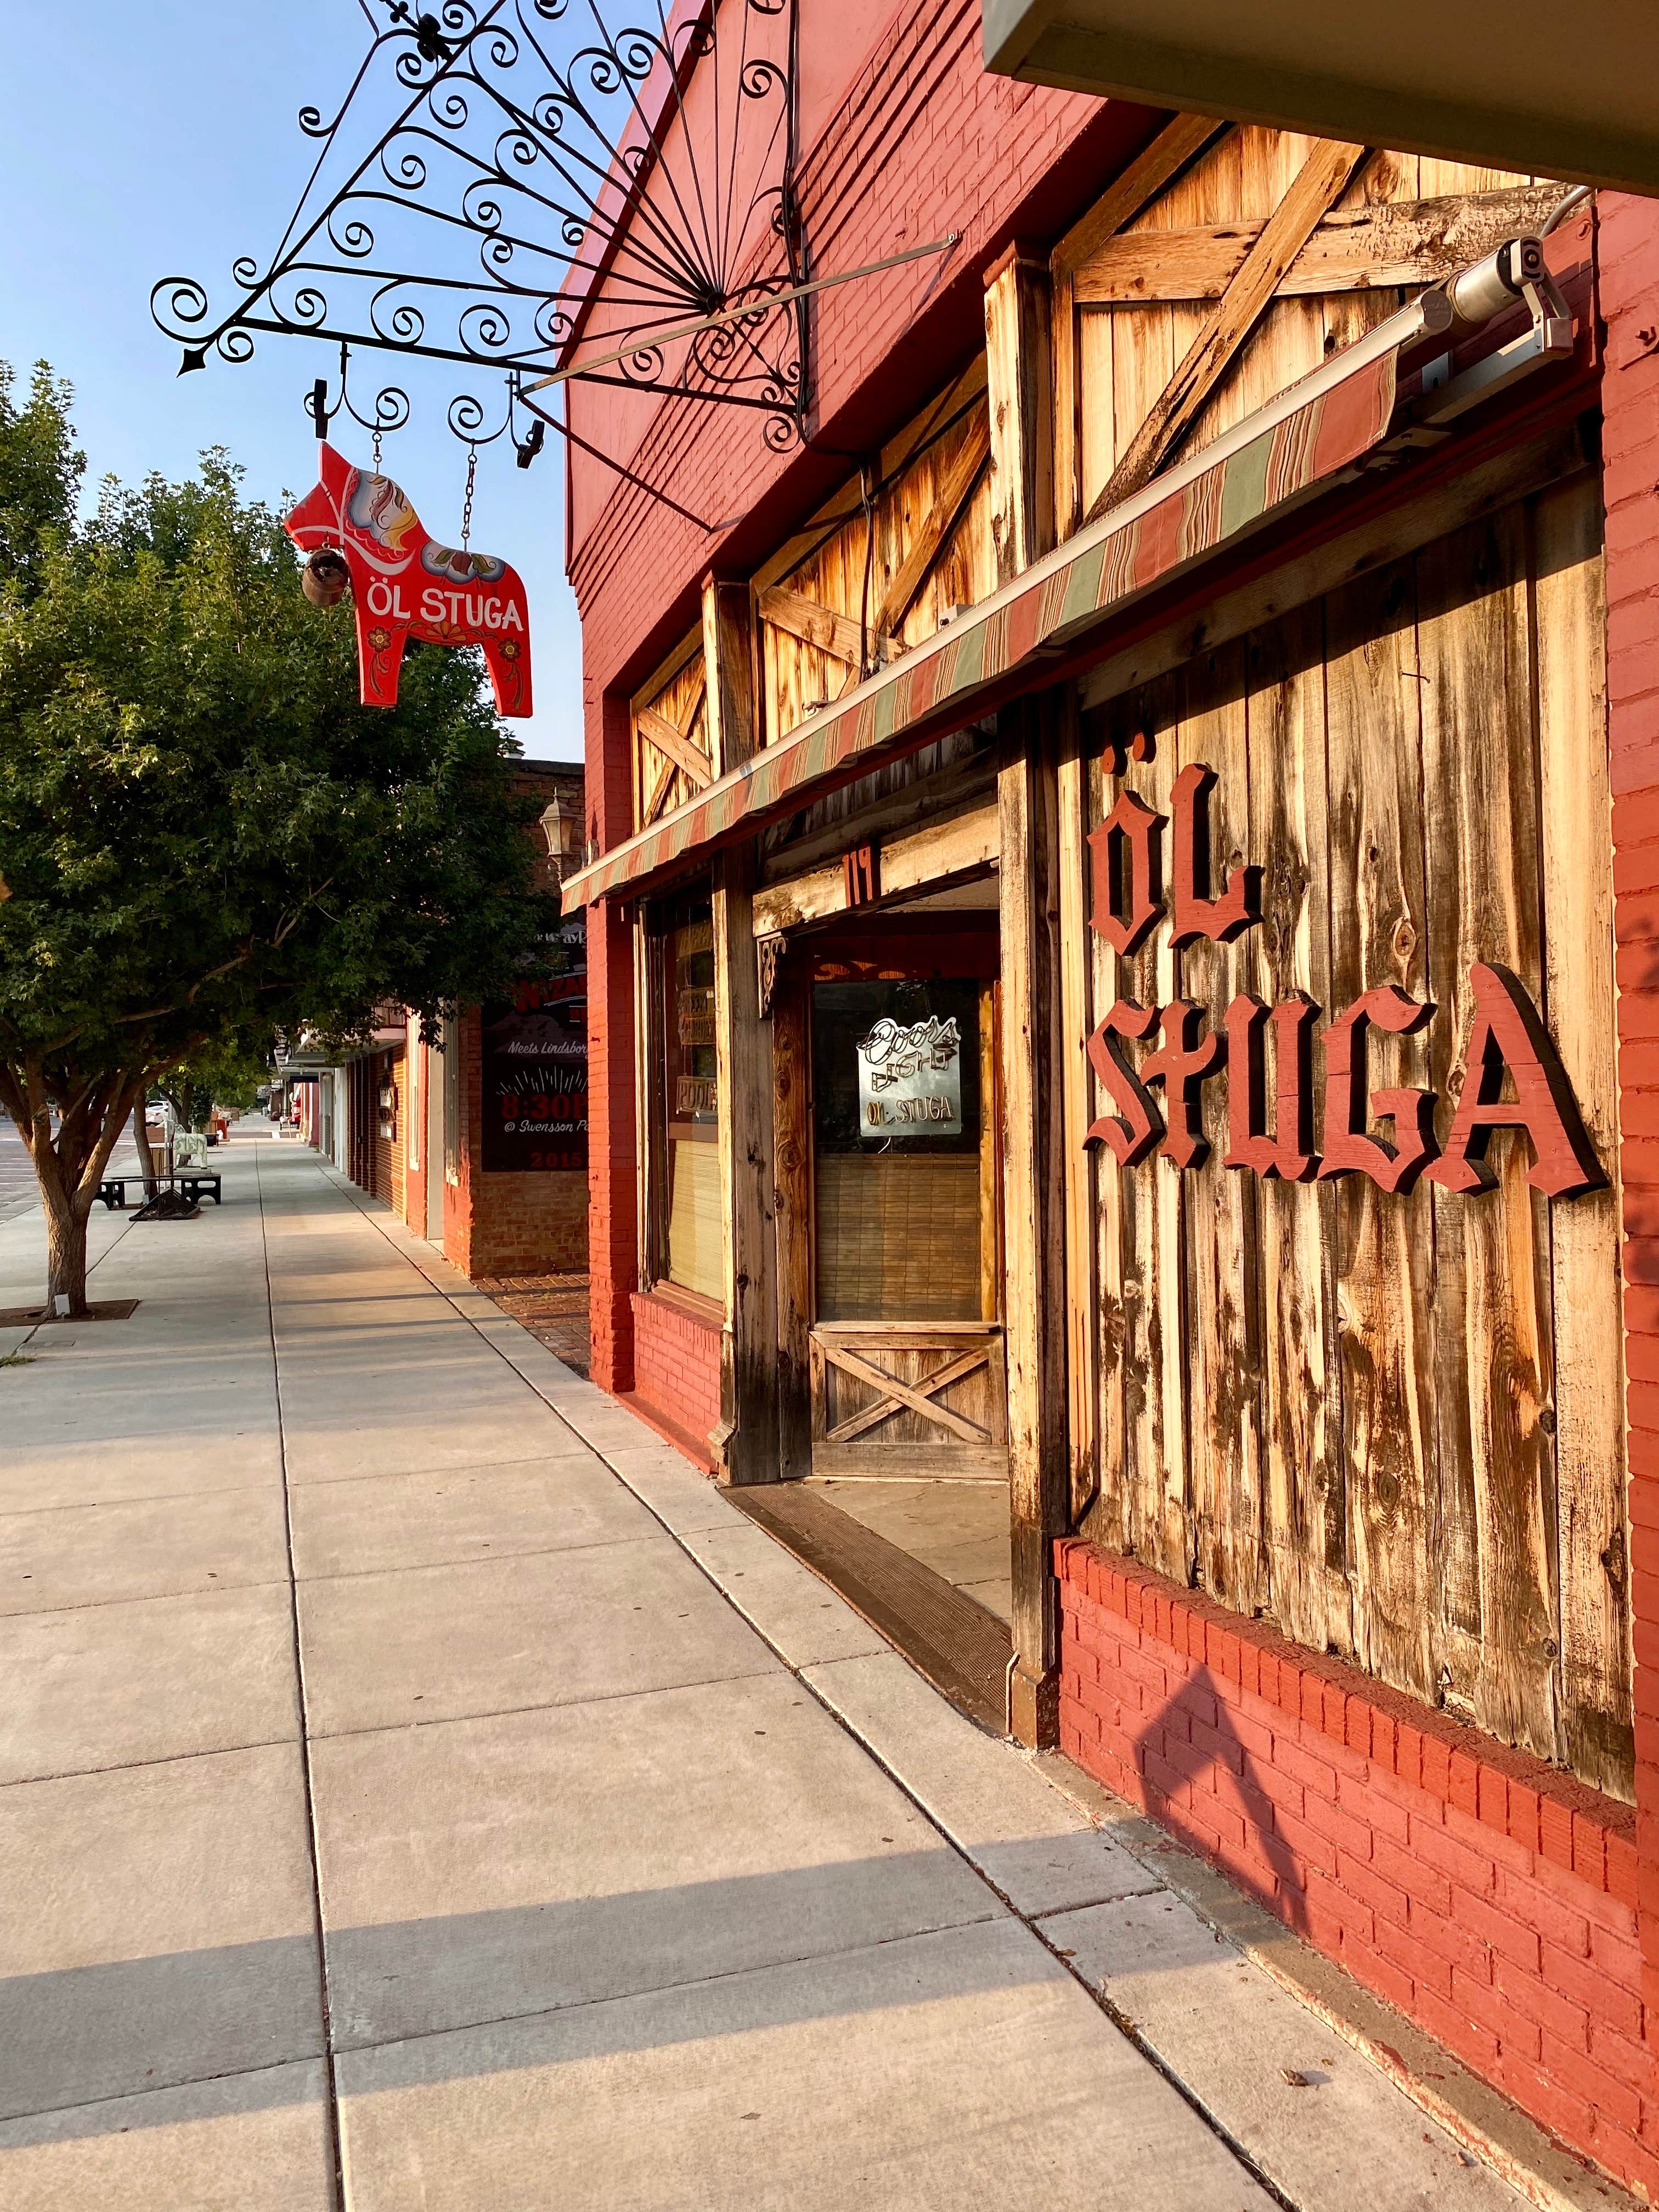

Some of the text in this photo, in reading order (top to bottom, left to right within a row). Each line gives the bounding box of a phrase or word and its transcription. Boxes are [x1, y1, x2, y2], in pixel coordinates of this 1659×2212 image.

[367, 576, 524, 631] ÖL STUGA
[1086, 731, 1266, 956] ÖL
[842, 846, 873, 907] 119
[508, 1041, 539, 1054] Meets
[503, 1094, 588, 1118] 8:30P
[895, 1096, 953, 1122] STUGA
[505, 1122, 515, 1132] @
[519, 1119, 573, 1132] Swensson
[531, 1151, 583, 1167] 2015
